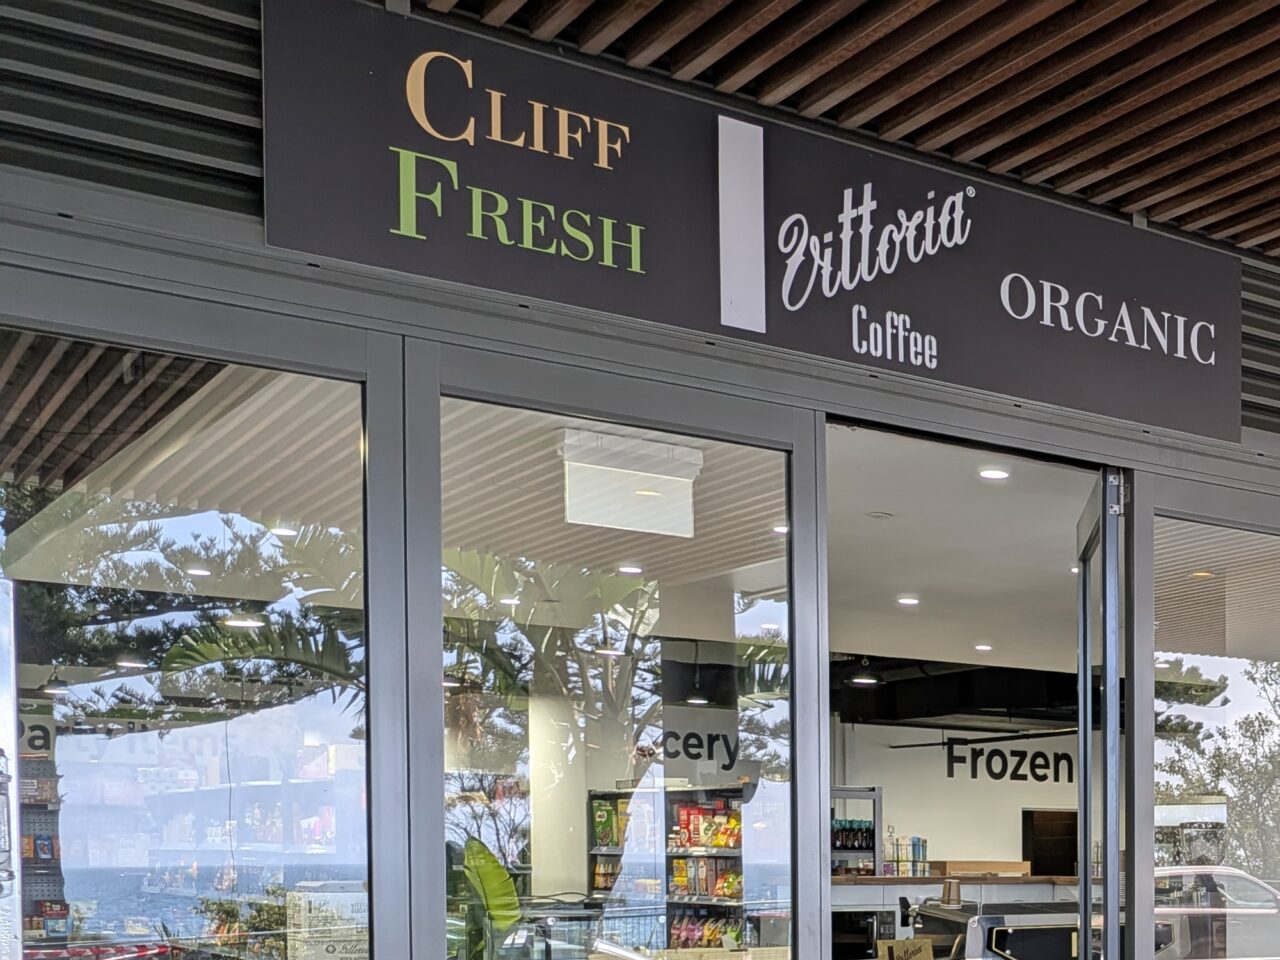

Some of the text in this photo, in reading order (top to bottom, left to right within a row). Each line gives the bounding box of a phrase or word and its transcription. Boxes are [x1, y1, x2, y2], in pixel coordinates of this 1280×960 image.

[406, 51, 630, 170] CLIFF
[389, 146, 646, 274] FRESH
[851, 304, 938, 369] Coffee
[1000, 273, 1216, 366] ORGANIC
[946, 737, 1074, 783] Frozen
